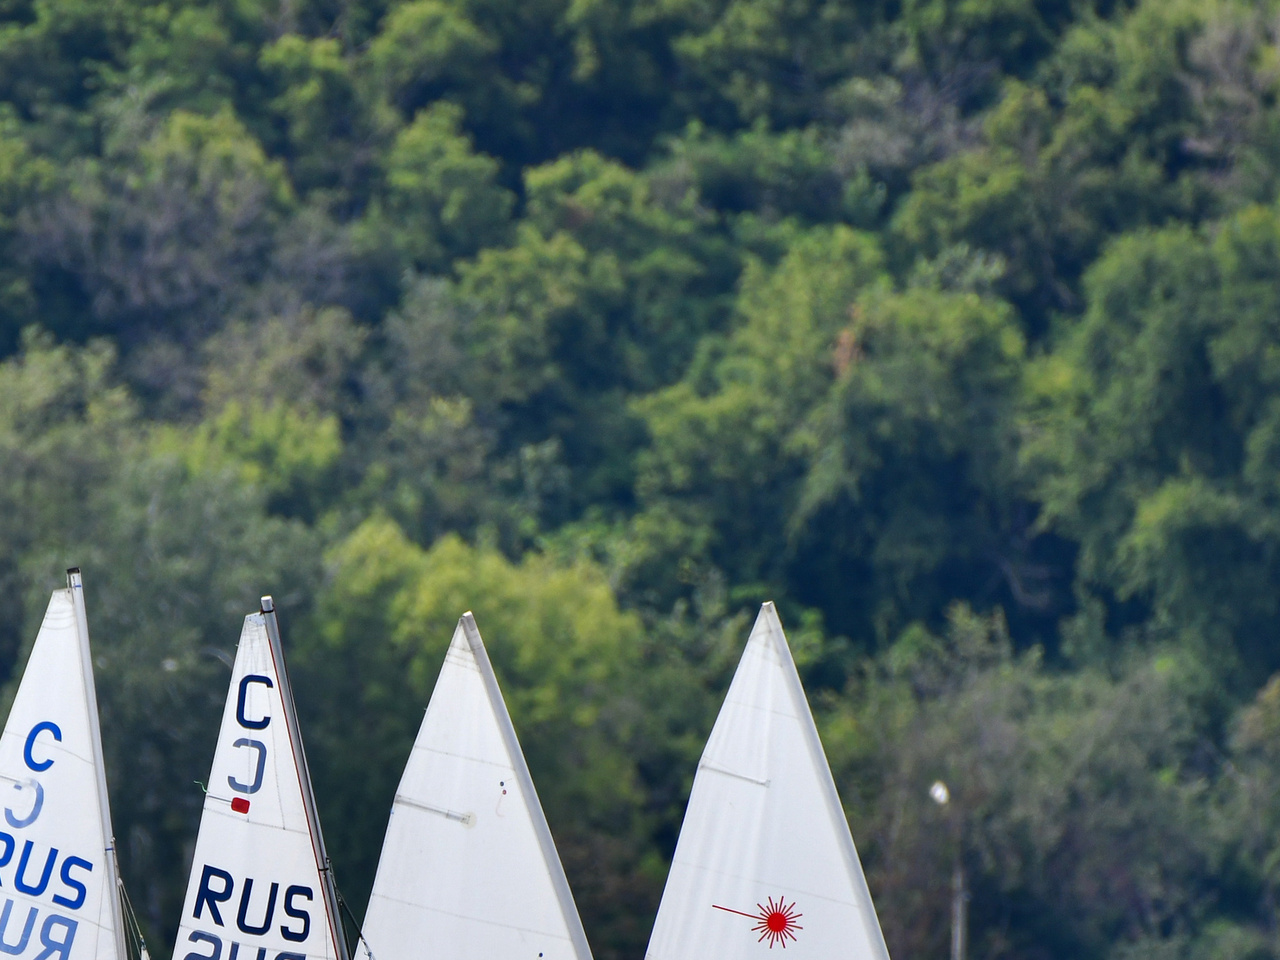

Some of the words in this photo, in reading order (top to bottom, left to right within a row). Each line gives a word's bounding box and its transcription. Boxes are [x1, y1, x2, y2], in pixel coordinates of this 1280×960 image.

[237, 674, 274, 730] C
[24, 721, 62, 772] C
[193, 865, 314, 942] RUS
